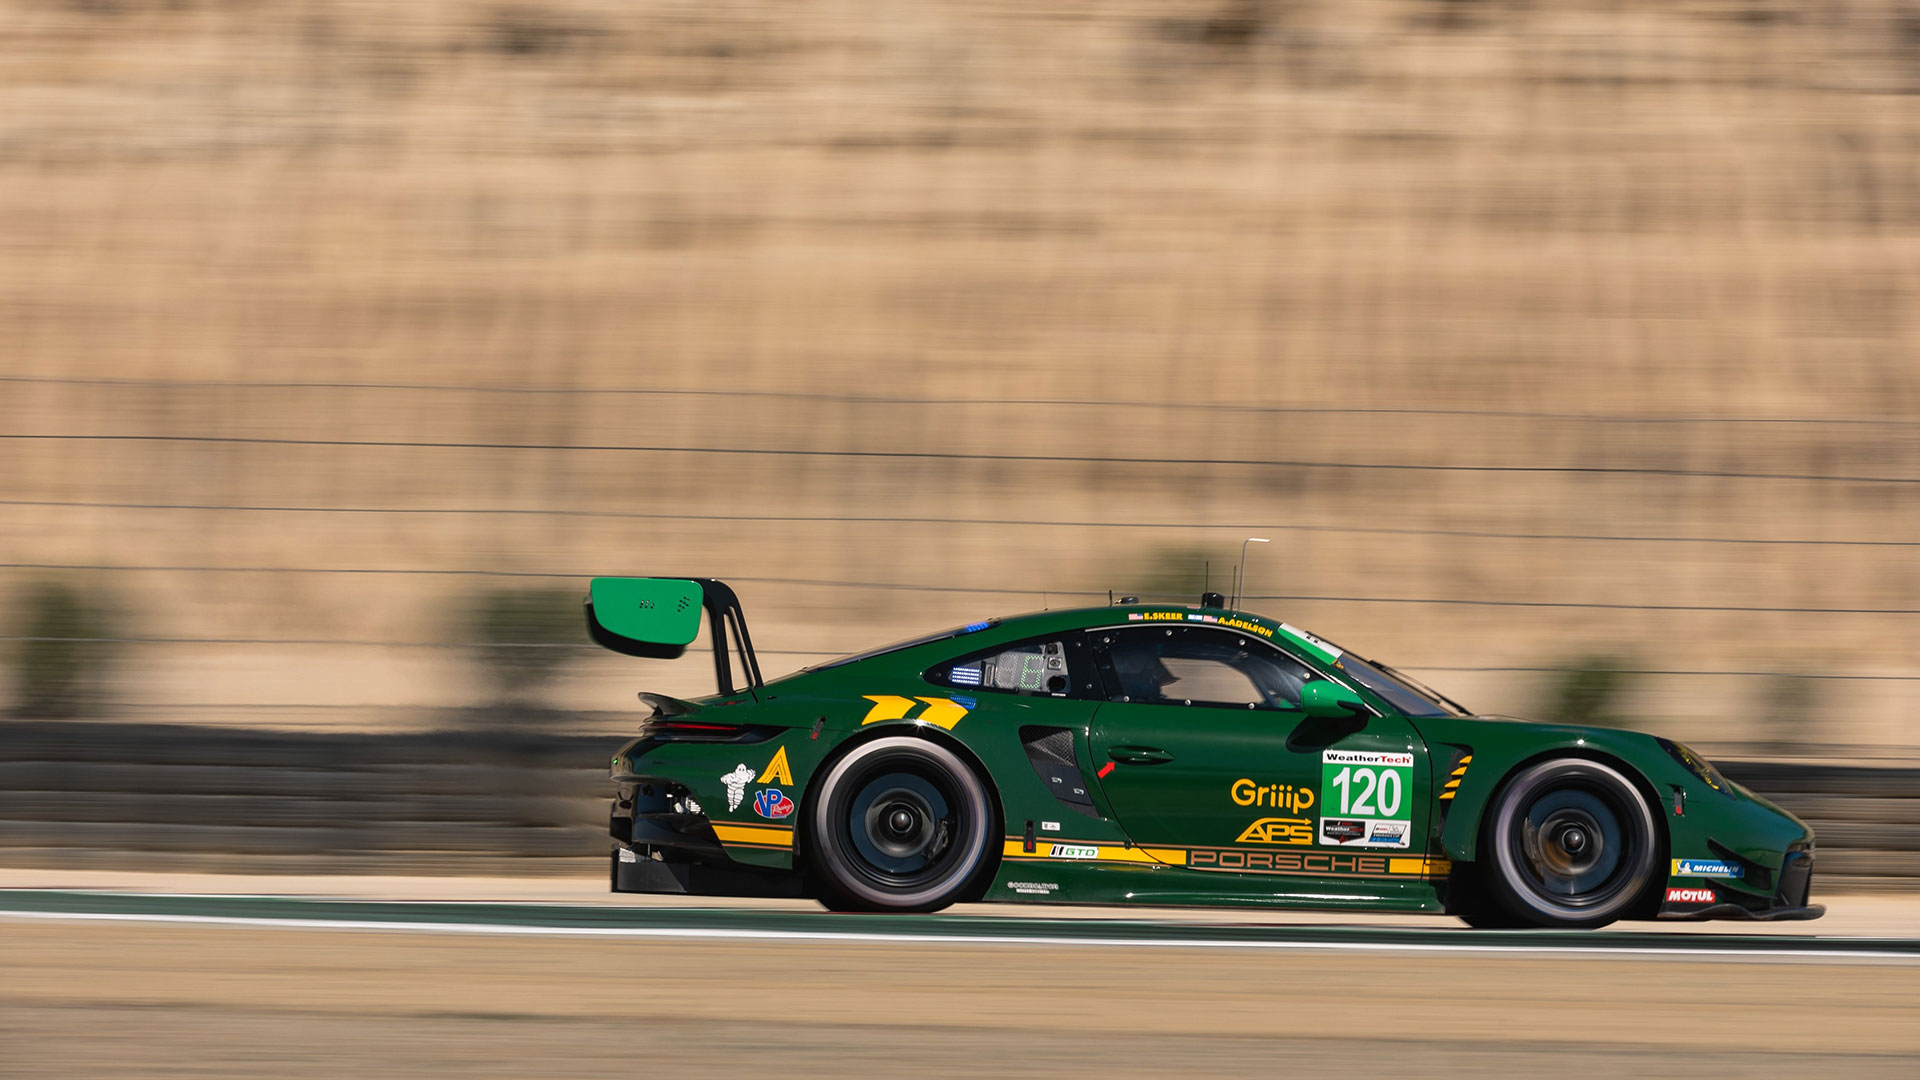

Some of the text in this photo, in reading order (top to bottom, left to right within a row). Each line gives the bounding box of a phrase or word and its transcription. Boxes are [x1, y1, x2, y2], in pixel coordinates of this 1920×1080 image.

[1143, 612, 1183, 621] E.SKEER
[1217, 616, 1273, 638] A.ADELSON
[1326, 753, 1411, 764] WeatherTech
[1231, 778, 1315, 815] Griiip
[1332, 766, 1402, 817] 120
[755, 788, 784, 818] VP
[1235, 817, 1313, 846] APS
[1065, 847, 1096, 857] GTD
[1190, 851, 1386, 873] PORSCHE
[1693, 864, 1740, 873] MICHELIN
[1668, 889, 1714, 901] MOTUL
